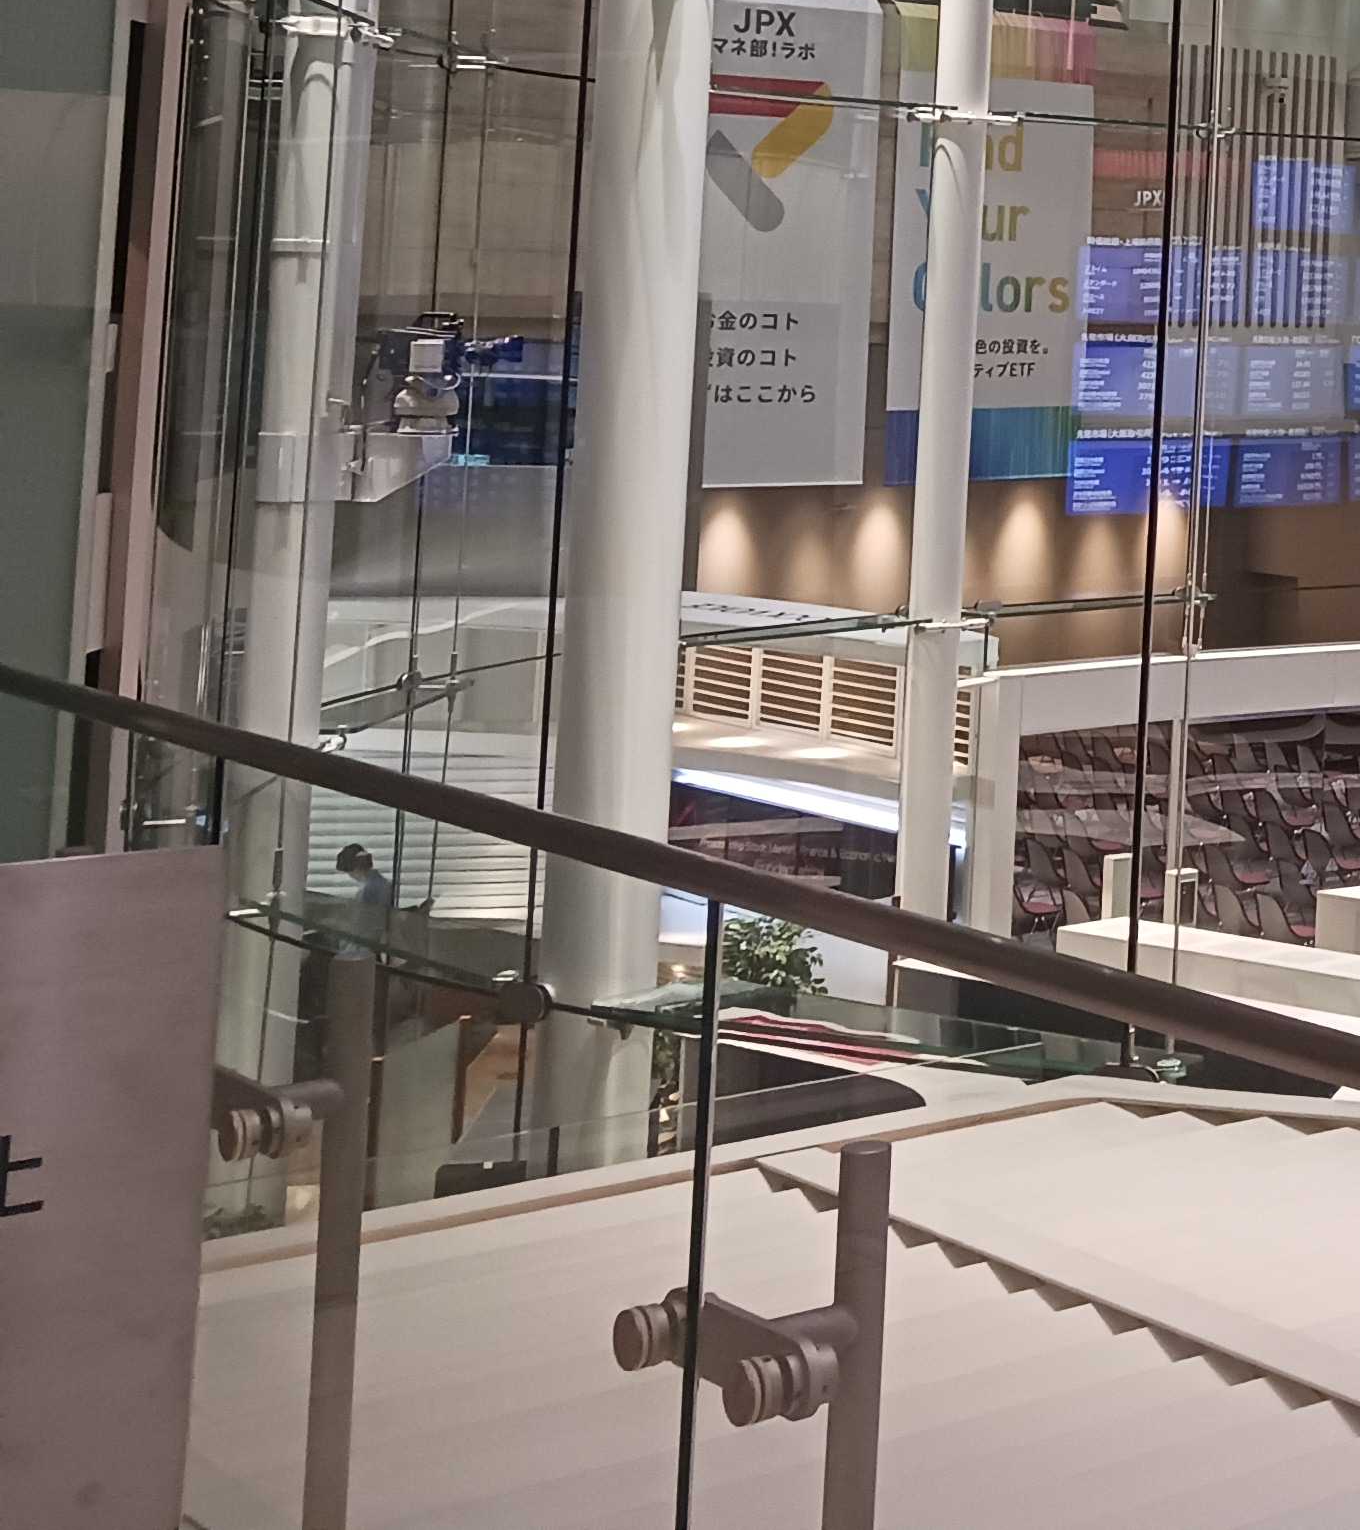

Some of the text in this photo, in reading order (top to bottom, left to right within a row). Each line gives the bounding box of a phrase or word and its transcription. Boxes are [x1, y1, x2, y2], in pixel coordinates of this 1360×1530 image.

[733, 8, 796, 37] JPX
[707, 384, 815, 404] はここから
